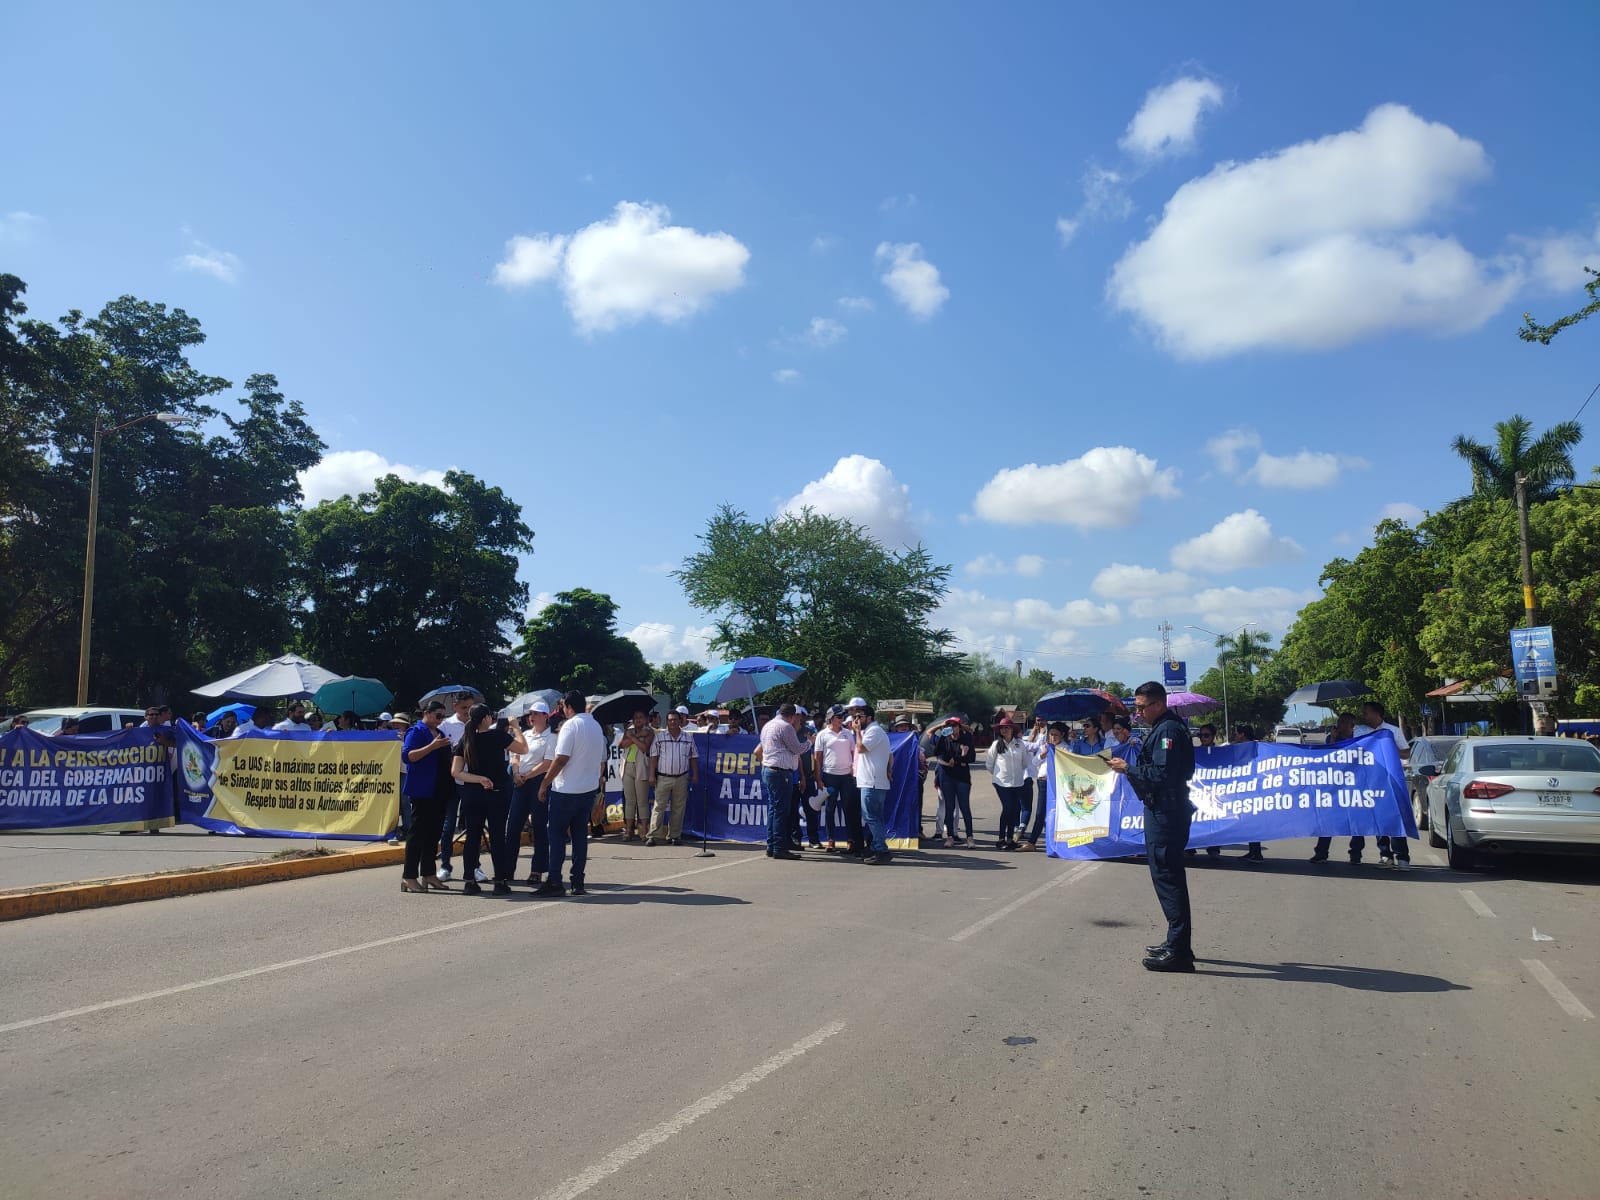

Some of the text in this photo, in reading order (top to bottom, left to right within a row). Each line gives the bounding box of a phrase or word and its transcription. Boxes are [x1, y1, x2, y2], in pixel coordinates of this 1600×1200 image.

[12, 749, 25, 767] A
[30, 749, 51, 767] LA
[55, 743, 166, 767] PERSECUCIÓN
[248, 756, 263, 772] UAS
[273, 758, 281, 773] la
[282, 757, 315, 774] máxima
[318, 761, 337, 775] casa
[339, 760, 349, 774] de
[350, 760, 383, 775] estudios
[29, 769, 58, 787] DEL
[64, 766, 165, 787] GOBERNADOR
[231, 773, 259, 789] Sinaloa
[261, 776, 272, 792] por
[275, 779, 288, 791] sus
[289, 776, 311, 792] altos
[313, 776, 343, 793] índices
[344, 776, 395, 794] Académicos:
[1262, 773, 1283, 790] de
[1288, 767, 1355, 786] Sinaloa
[0, 786, 145, 808] CONTRA DE LA UAS
[719, 778, 762, 800] A LA
[245, 791, 276, 810] Respeto
[279, 794, 297, 810] total
[298, 798, 304, 809] a
[306, 797, 316, 809] su
[1222, 791, 1293, 817] respeto
[1298, 793, 1310, 808] a
[1315, 788, 1332, 808] la
